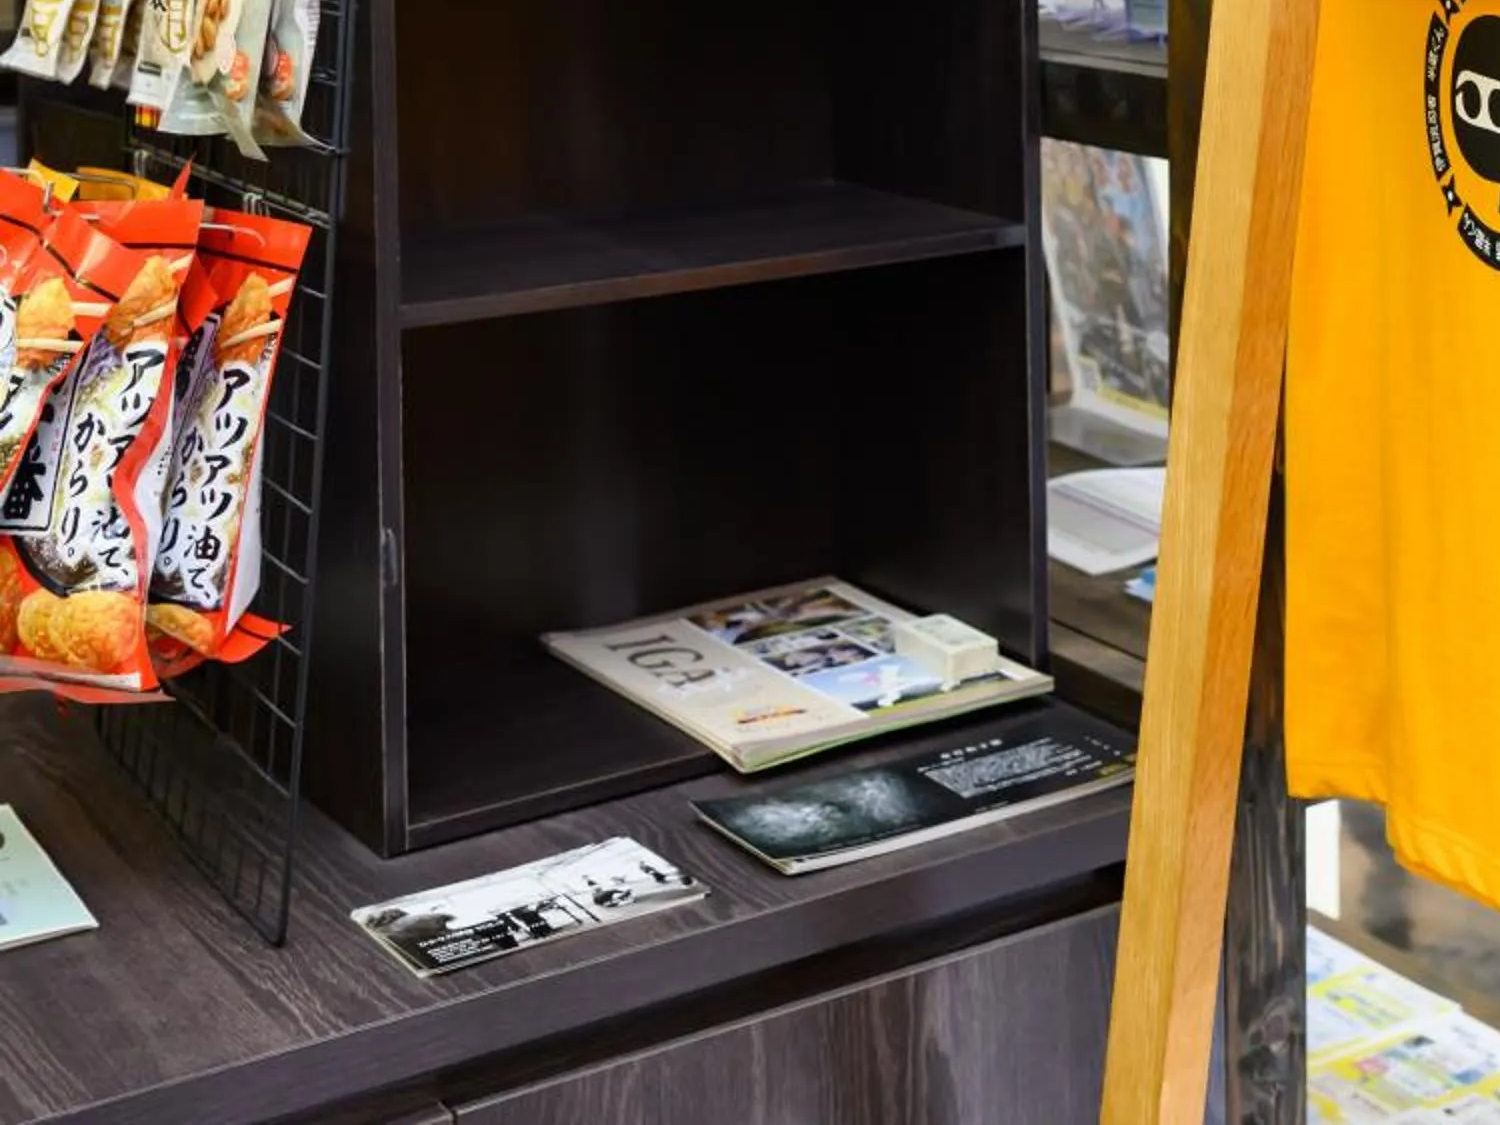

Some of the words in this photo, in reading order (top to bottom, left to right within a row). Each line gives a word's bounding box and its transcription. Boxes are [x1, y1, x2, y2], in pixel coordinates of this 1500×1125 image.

[183, 367, 251, 600] アツアツ油で、
[606, 633, 716, 688] IGA
